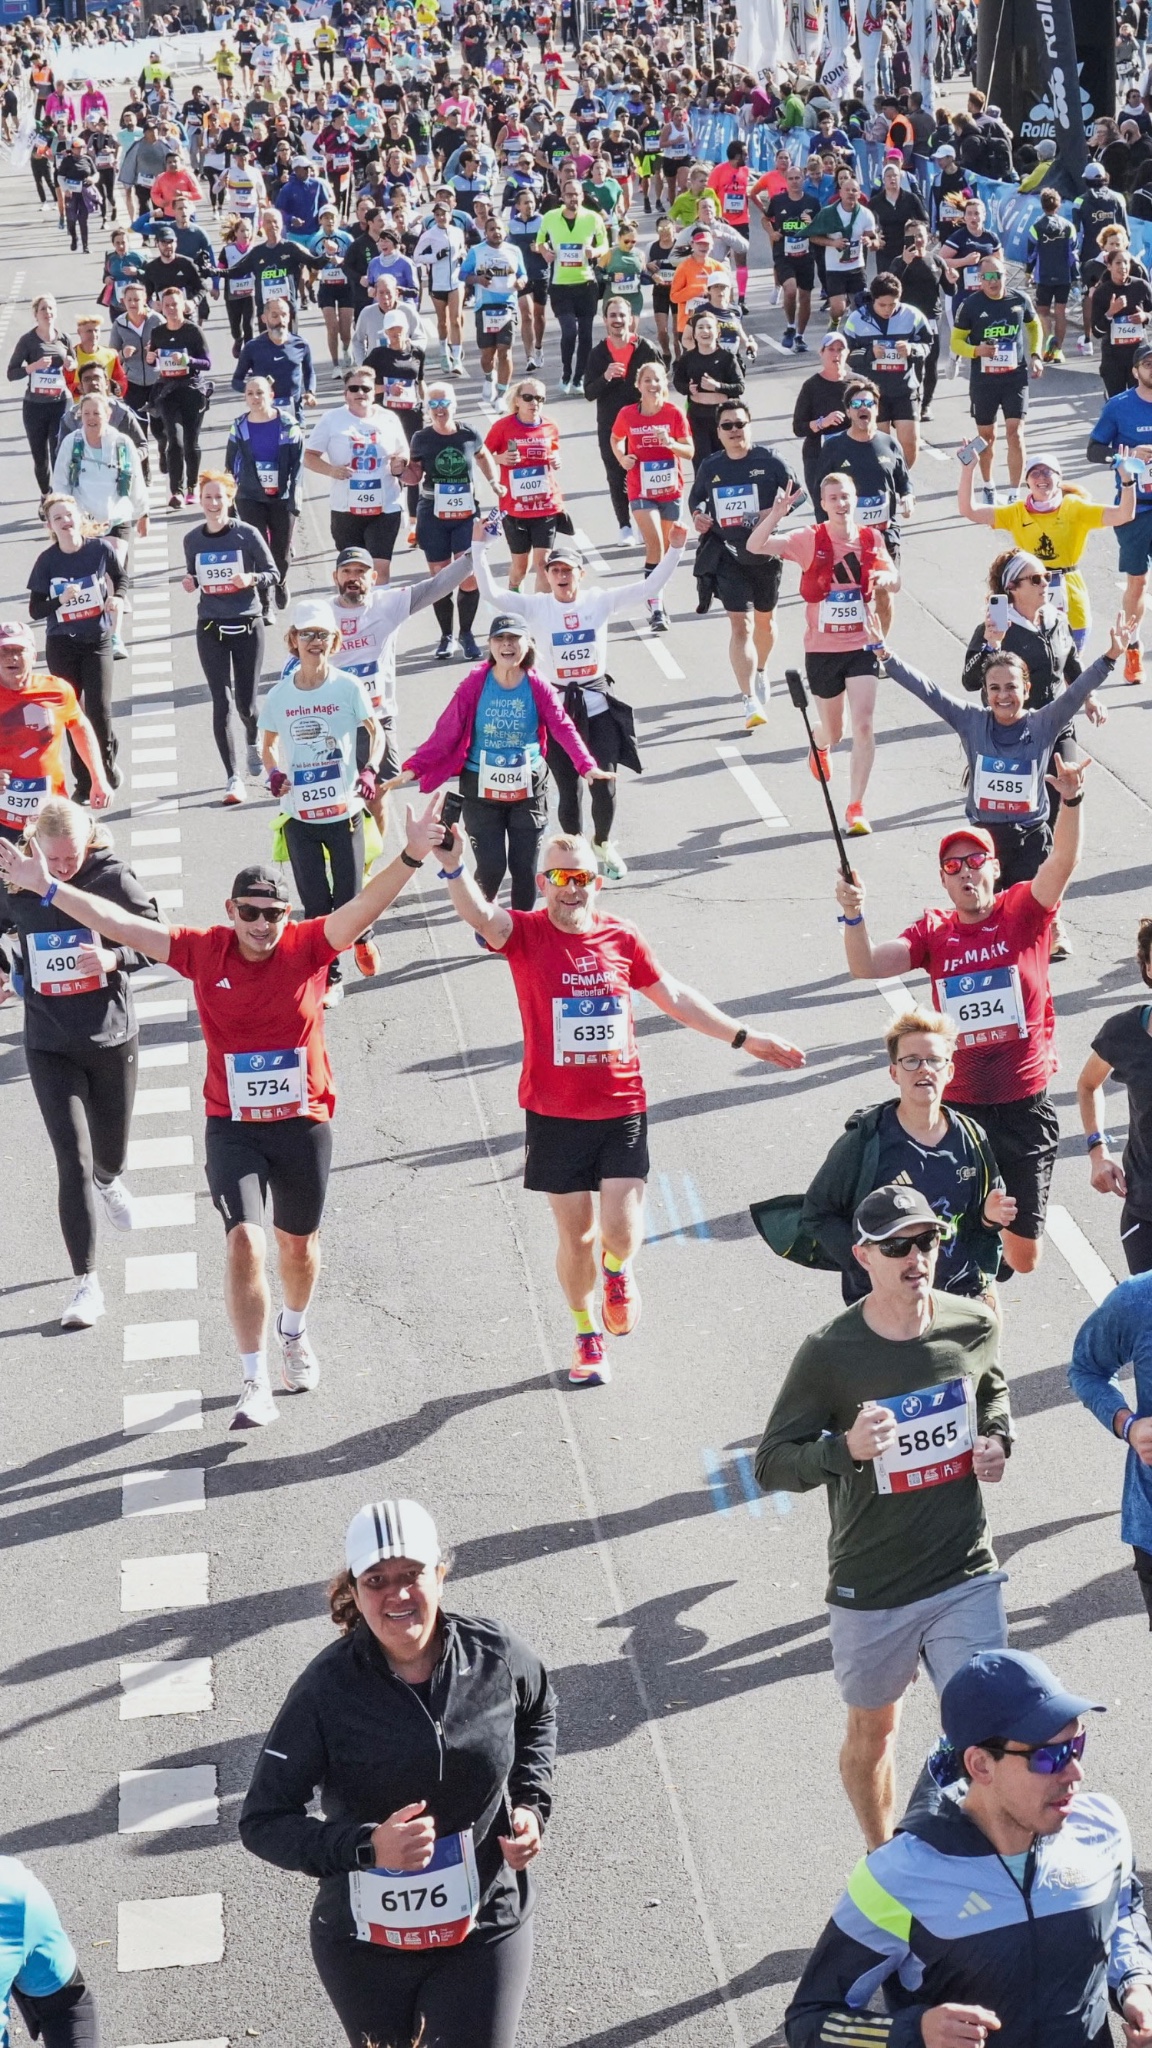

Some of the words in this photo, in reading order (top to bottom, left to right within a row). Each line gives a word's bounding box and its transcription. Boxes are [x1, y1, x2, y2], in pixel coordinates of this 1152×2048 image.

[261, 268, 287, 279] BERLIN
[984, 325, 1019, 339] BERLIN
[1118, 326, 1136, 334] 7646
[352, 443, 378, 457] CA
[519, 480, 542, 490] 4007
[357, 493, 375, 503] 496
[446, 497, 464, 507] 495
[725, 500, 747, 511] 4721
[862, 509, 883, 520] 2177
[206, 567, 233, 579] 9363
[831, 606, 858, 618] 7558
[339, 637, 369, 652] AREK
[560, 648, 591, 661] 4652
[285, 704, 311, 717] Berlin
[313, 703, 340, 715] Magic
[485, 707, 527, 719] COURAGE
[490, 771, 522, 784] 4084
[987, 779, 1023, 794] 4585
[301, 785, 336, 802] 8250
[7, 795, 39, 808] 8370
[46, 954, 82, 972] 490
[562, 970, 619, 986] DENMARK
[959, 998, 1005, 1021] 6334
[573, 1024, 615, 1041] 6335
[246, 1077, 290, 1097] 5734
[898, 1420, 958, 1456] 5865
[381, 1883, 448, 1912] 6176
